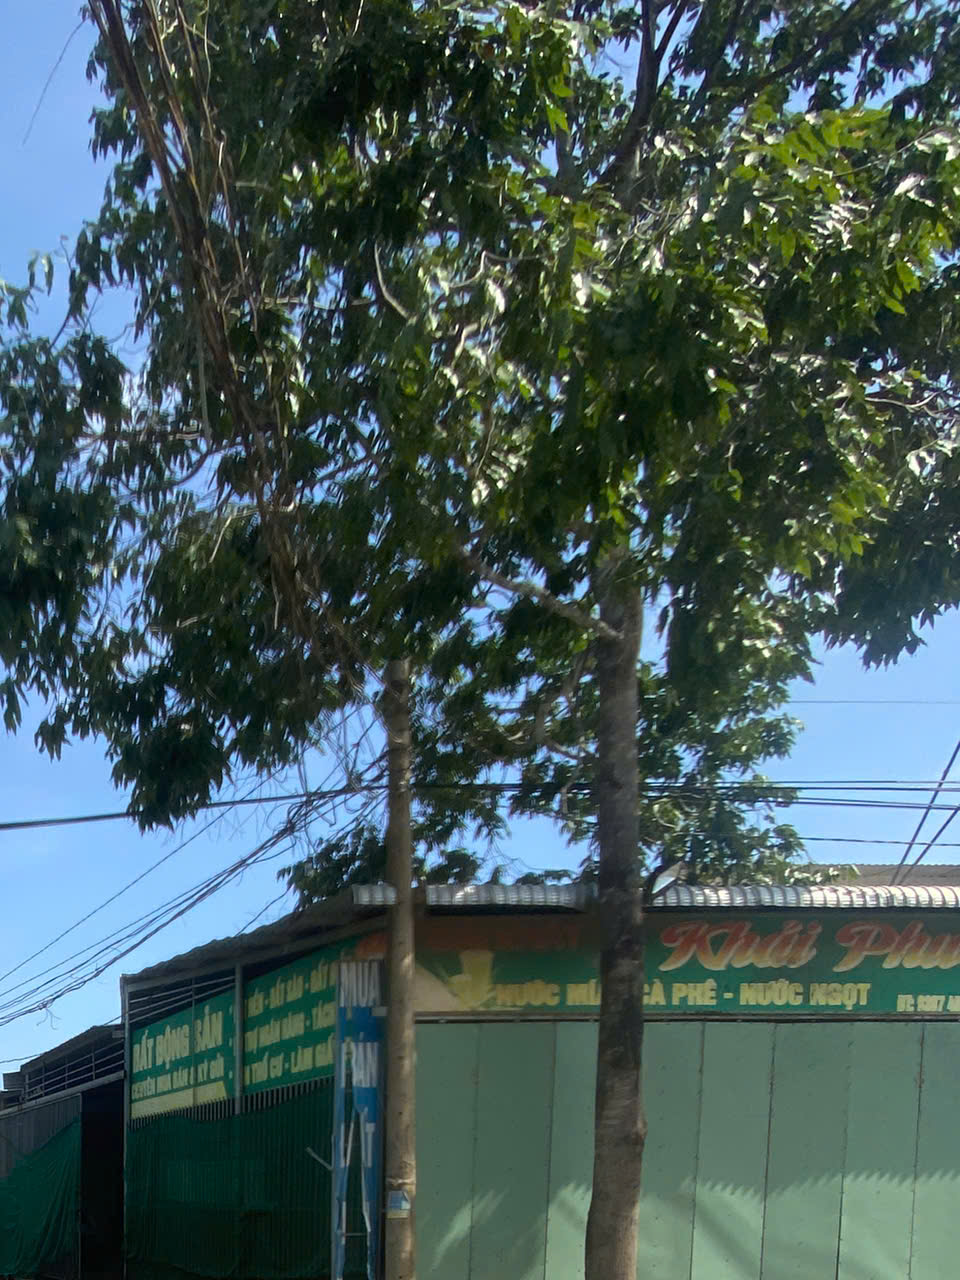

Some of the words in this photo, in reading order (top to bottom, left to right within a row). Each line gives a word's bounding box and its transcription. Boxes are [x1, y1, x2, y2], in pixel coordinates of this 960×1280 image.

[496, 979, 561, 1006] NƯỚC
[566, 978, 602, 1006] MÍ
[671, 979, 718, 1006] PHÊ
[739, 978, 804, 1006] NƯỚC
[809, 982, 872, 1010] NGỌT
